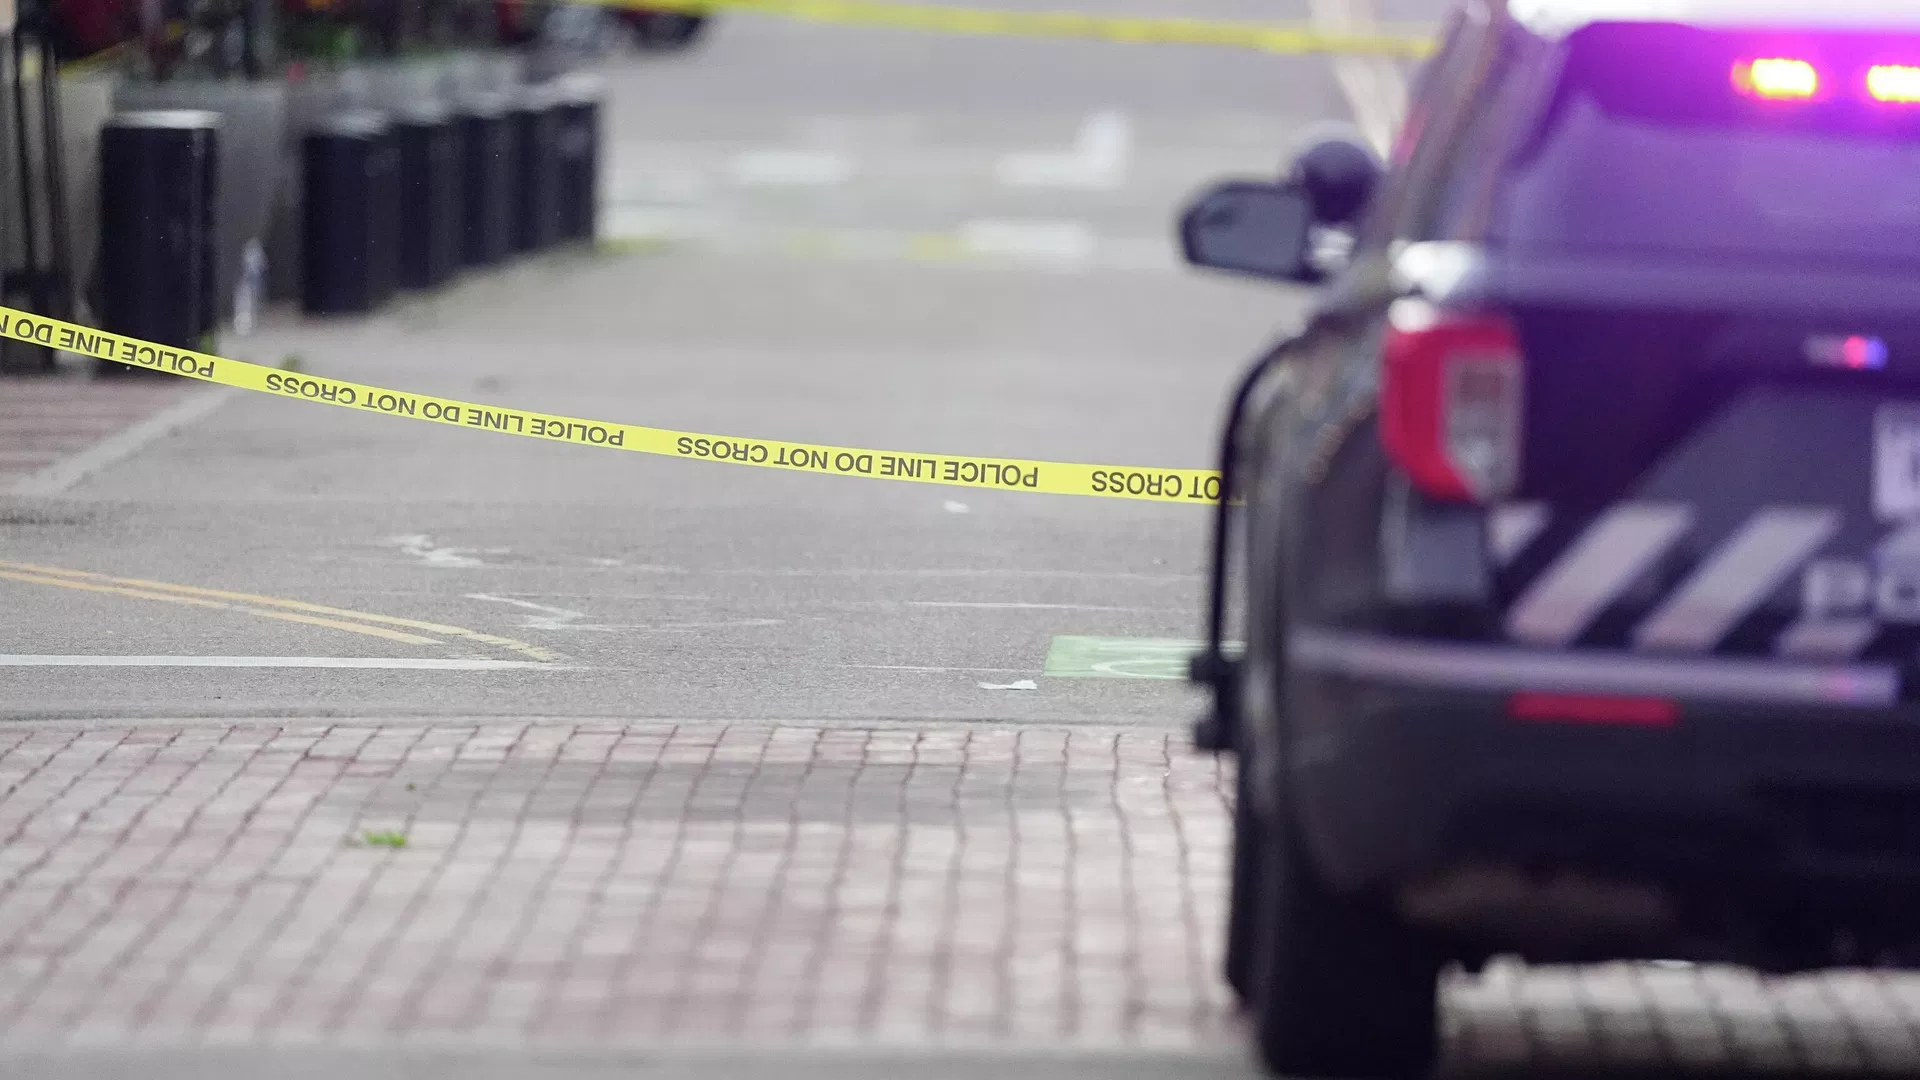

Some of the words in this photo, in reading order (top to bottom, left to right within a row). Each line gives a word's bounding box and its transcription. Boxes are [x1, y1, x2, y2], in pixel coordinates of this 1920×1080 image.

[15, 318, 54, 344] DO
[58, 327, 116, 357] LINE
[121, 342, 215, 378] POLICE
[267, 374, 357, 404] CROSS
[361, 392, 416, 415] NOT
[422, 402, 461, 422] DO
[468, 409, 525, 432] LINE
[531, 419, 625, 446] POLICE
[678, 436, 768, 463] CROSS
[773, 447, 829, 469] NOT
[835, 452, 874, 473] DO
[881, 457, 938, 479] LINE
[944, 461, 1039, 488] POLICE
[1091, 470, 1182, 498] CROSS
[1187, 475, 1223, 500] OT
